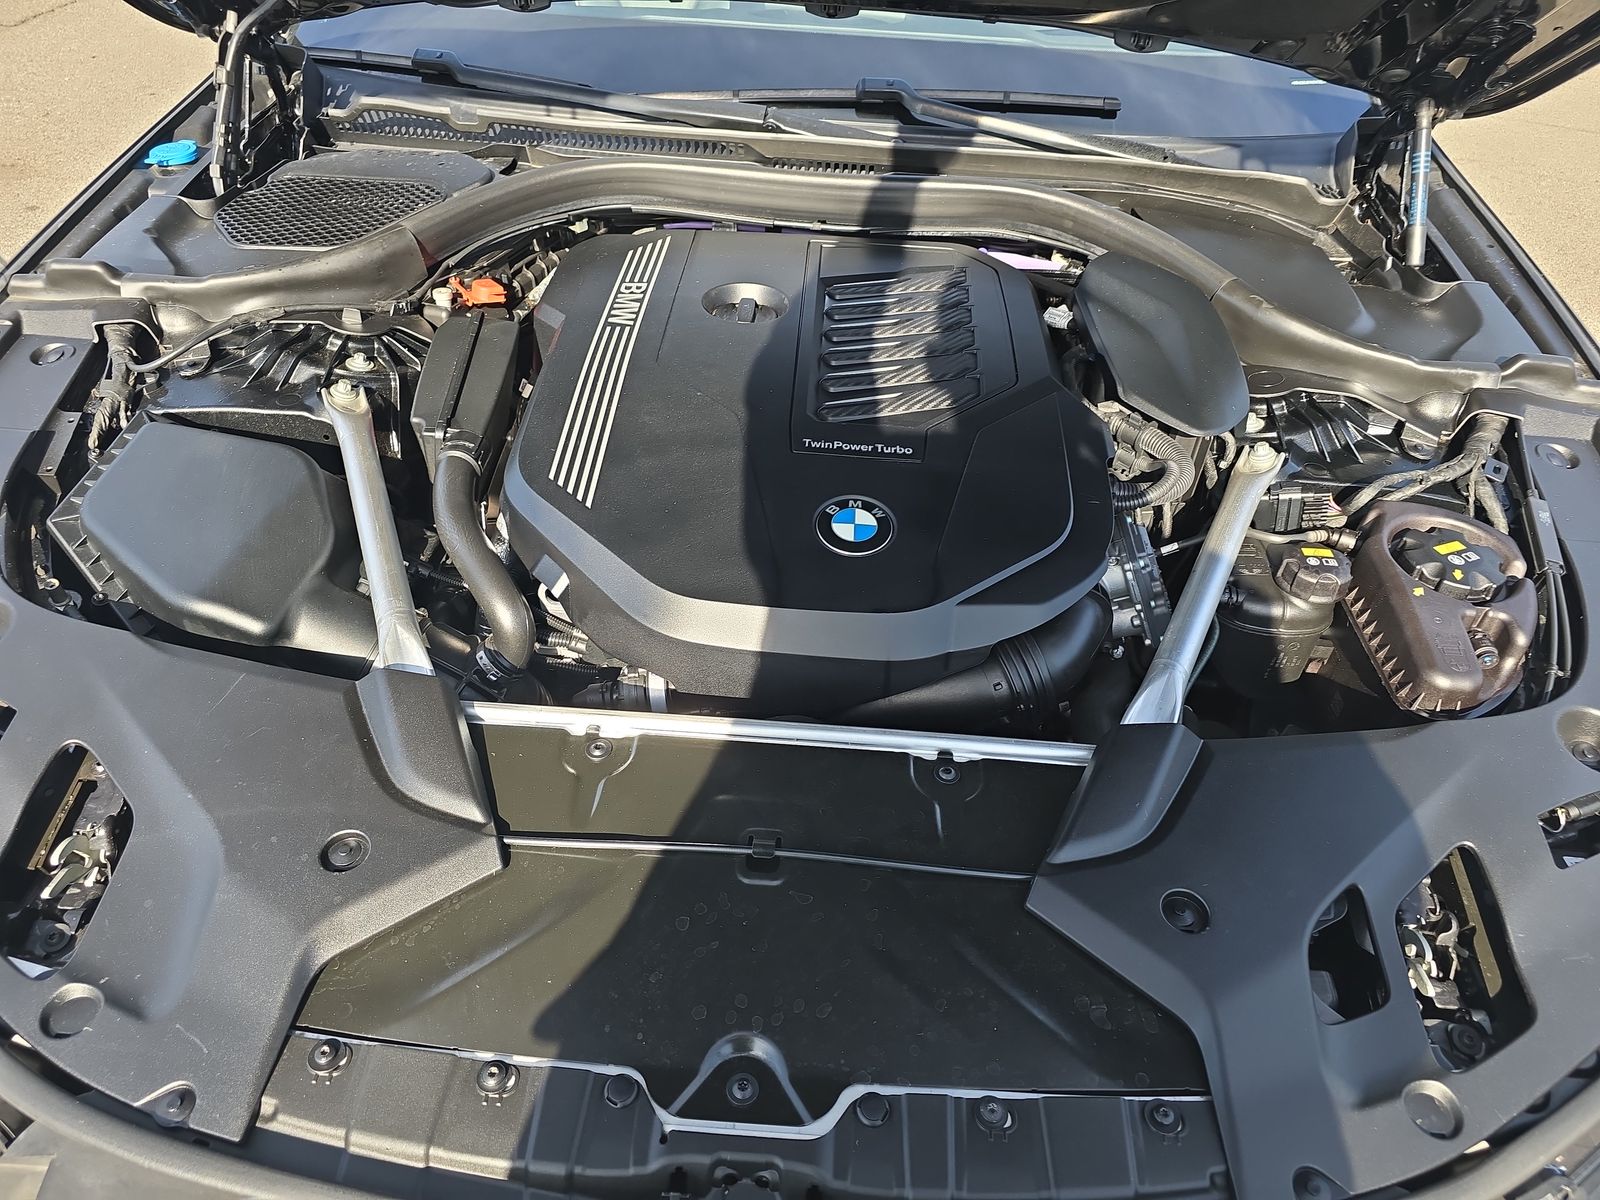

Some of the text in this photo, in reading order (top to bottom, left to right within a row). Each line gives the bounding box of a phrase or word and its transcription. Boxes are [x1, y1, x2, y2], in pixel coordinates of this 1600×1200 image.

[607, 281, 648, 326] BMW
[803, 438, 913, 454] TwinPower Turbo
[825, 500, 886, 519] BMW
